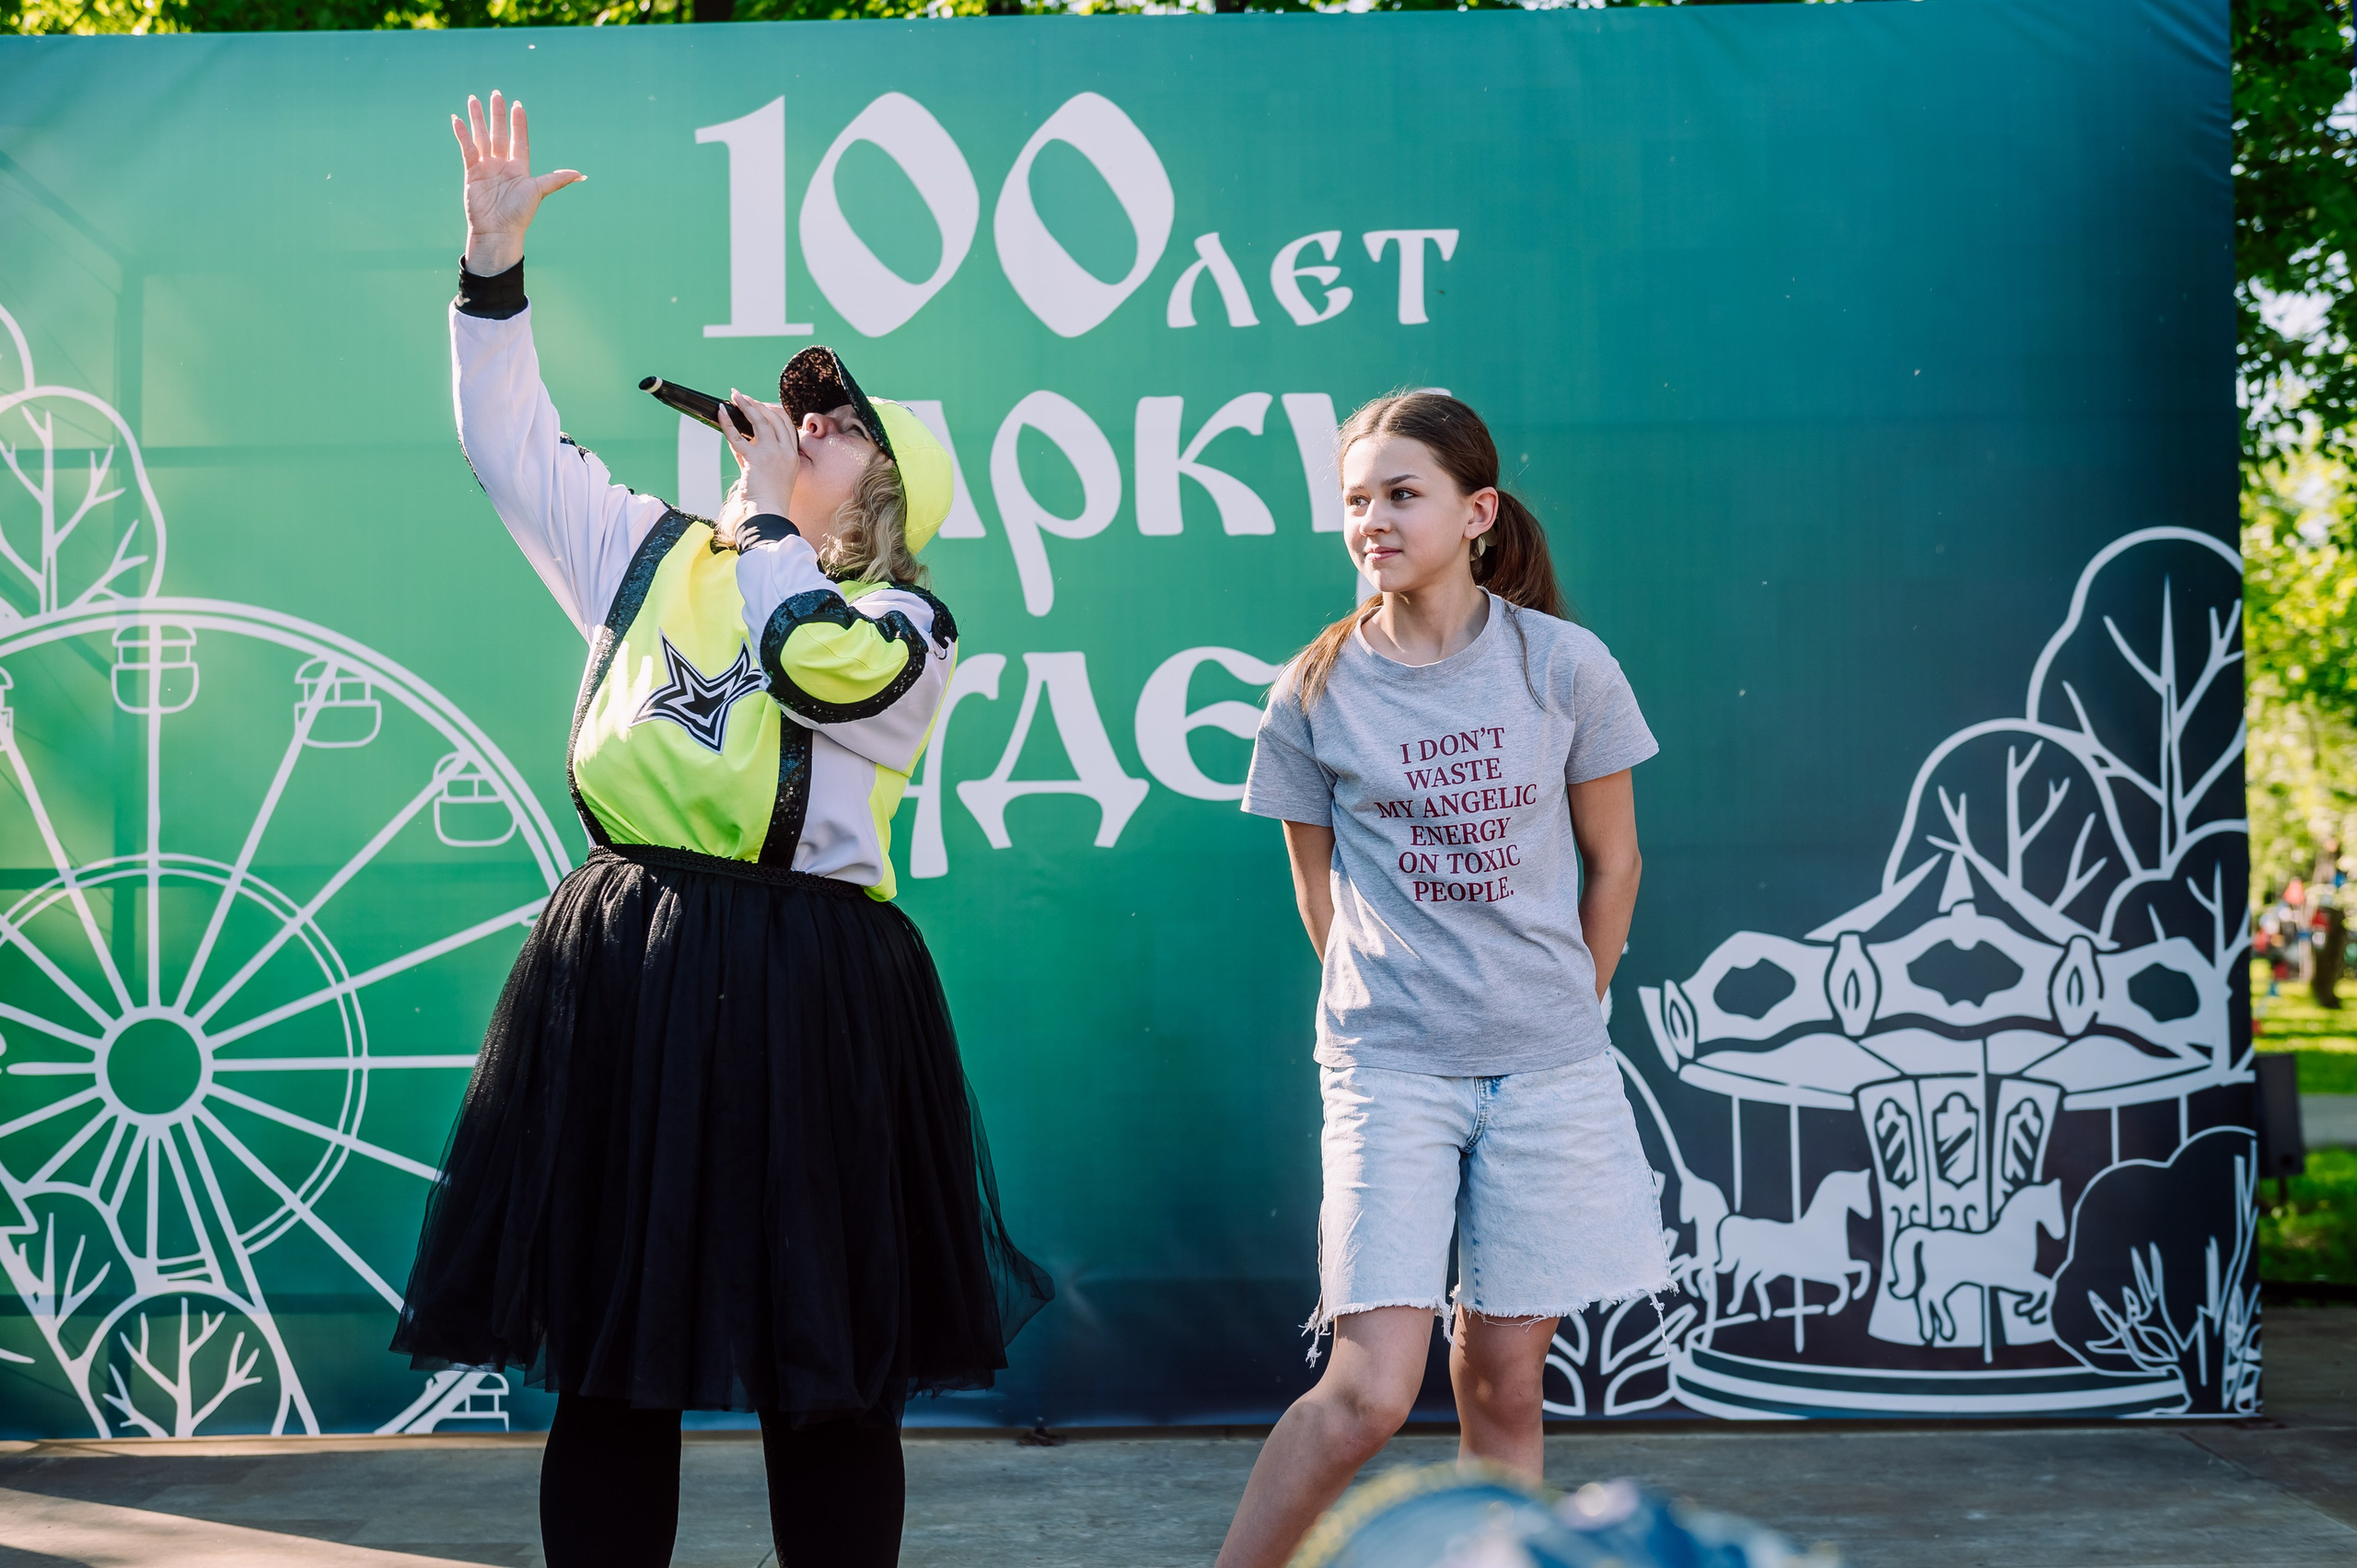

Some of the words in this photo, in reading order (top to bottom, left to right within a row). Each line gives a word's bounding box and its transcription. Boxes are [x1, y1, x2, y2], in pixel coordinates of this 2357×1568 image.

[694, 91, 1175, 338] 100
[1399, 743, 1416, 765] I
[1418, 726, 1505, 761] DON’T
[1404, 757, 1502, 791] WASTE
[1374, 799, 1414, 819] MY
[1422, 784, 1537, 819] ANGELIC
[1410, 817, 1511, 846] ENERGY
[1398, 851, 1440, 874] ON
[1446, 844, 1520, 874] TOXIC
[1412, 876, 1515, 902] PEOPLE.
